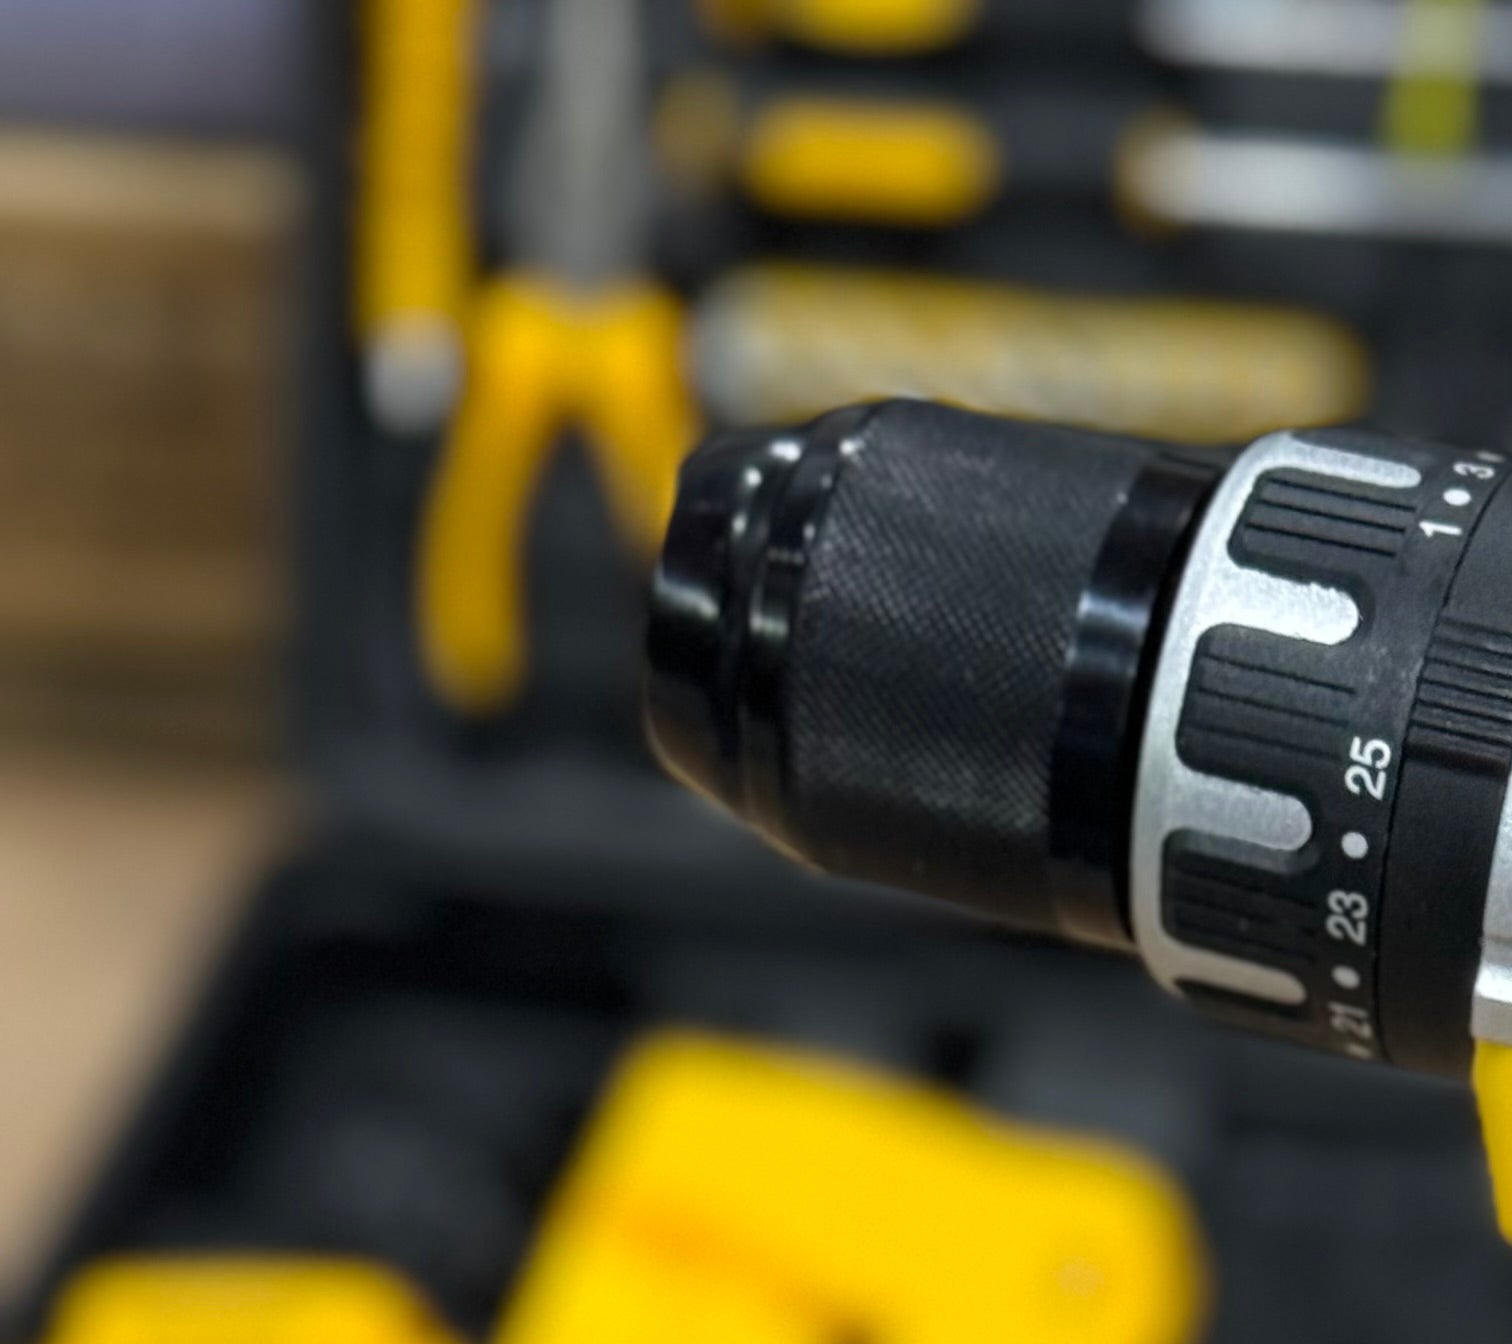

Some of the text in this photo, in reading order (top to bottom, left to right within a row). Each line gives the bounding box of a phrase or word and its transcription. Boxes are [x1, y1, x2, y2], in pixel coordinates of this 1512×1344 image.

[1419, 461, 1494, 538] 1 3
[1345, 736, 1391, 800] 25
[1325, 890, 1368, 946] 23
